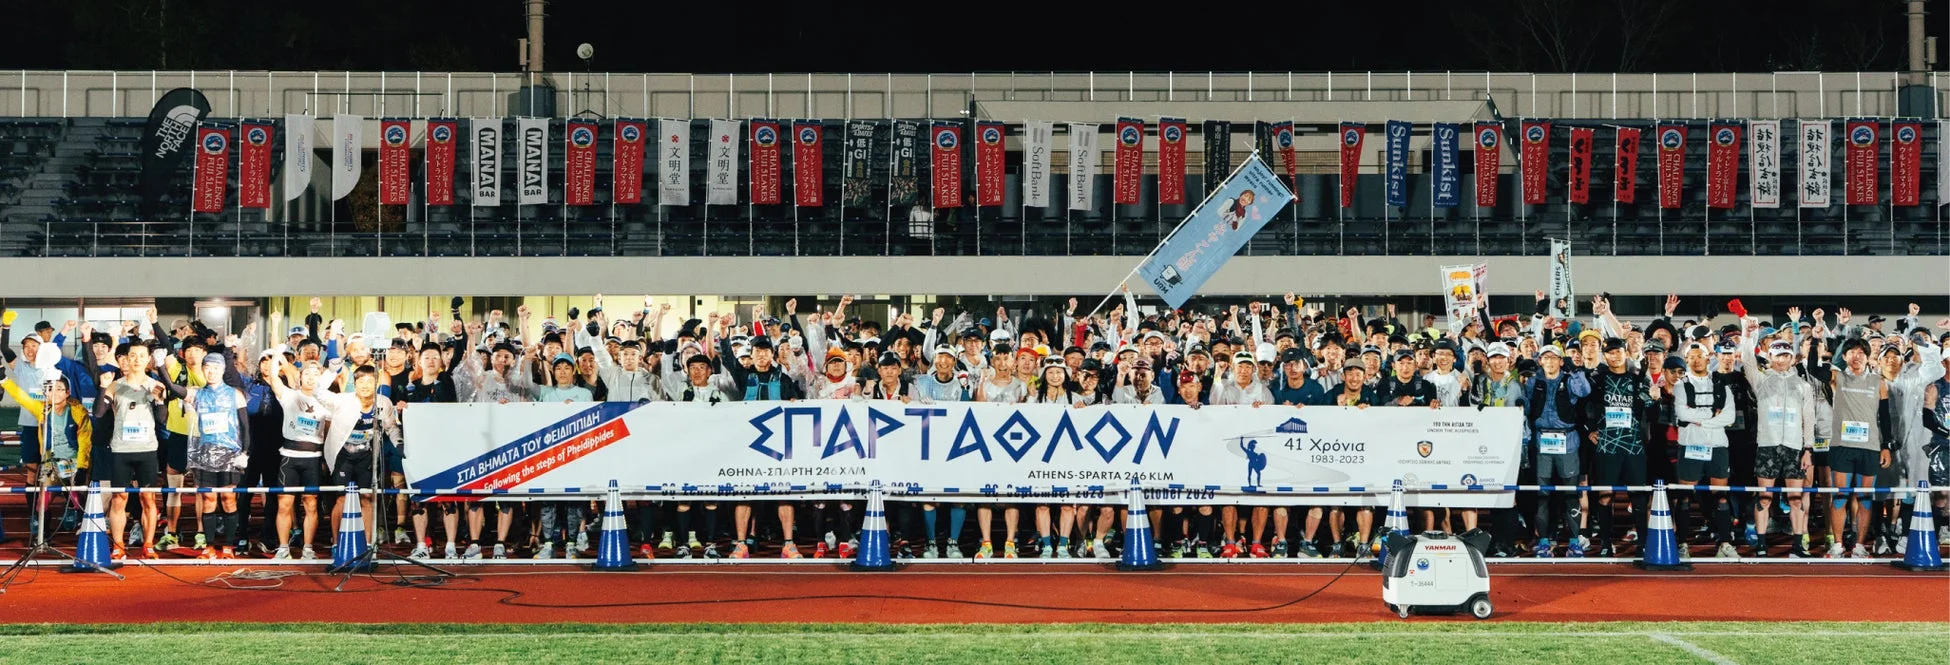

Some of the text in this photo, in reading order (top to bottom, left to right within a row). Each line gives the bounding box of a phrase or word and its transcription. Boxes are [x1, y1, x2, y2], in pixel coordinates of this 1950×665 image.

[155, 120, 182, 158] NORTH
[156, 117, 172, 138] THE
[170, 126, 190, 152] FACE
[480, 130, 494, 188] MANA
[526, 130, 542, 186] MANA
[668, 146, 681, 185] 文明堂
[717, 146, 730, 184] 文明堂
[1032, 146, 1044, 200] SoftBank
[1076, 149, 1088, 203] SoftBank
[1391, 125, 1406, 198] Sunkist
[1438, 127, 1456, 200] Sunkist
[1154, 278, 1169, 294] URM
[1604, 394, 1633, 403] QATAR
[457, 411, 600, 484] ΣΤΑ ΒΗΜΑΤΑ ΤΟΥ ΦΕΙΔΙΠΠΙΔΗ
[748, 404, 1180, 464] ΣΠΑΡΤΑΘΛΟΝ
[1284, 438, 1365, 454] 41 Χρόνια
[483, 429, 615, 490] Following the steps of Pheidippides
[718, 466, 866, 477] ΑΘΗΝΑ-ΣΠΑΡΤΗ 246 ΧΛΜ
[1028, 470, 1174, 480] ATHENS-SPARTA 246 KLM
[1311, 455, 1365, 464] 1983-2023
